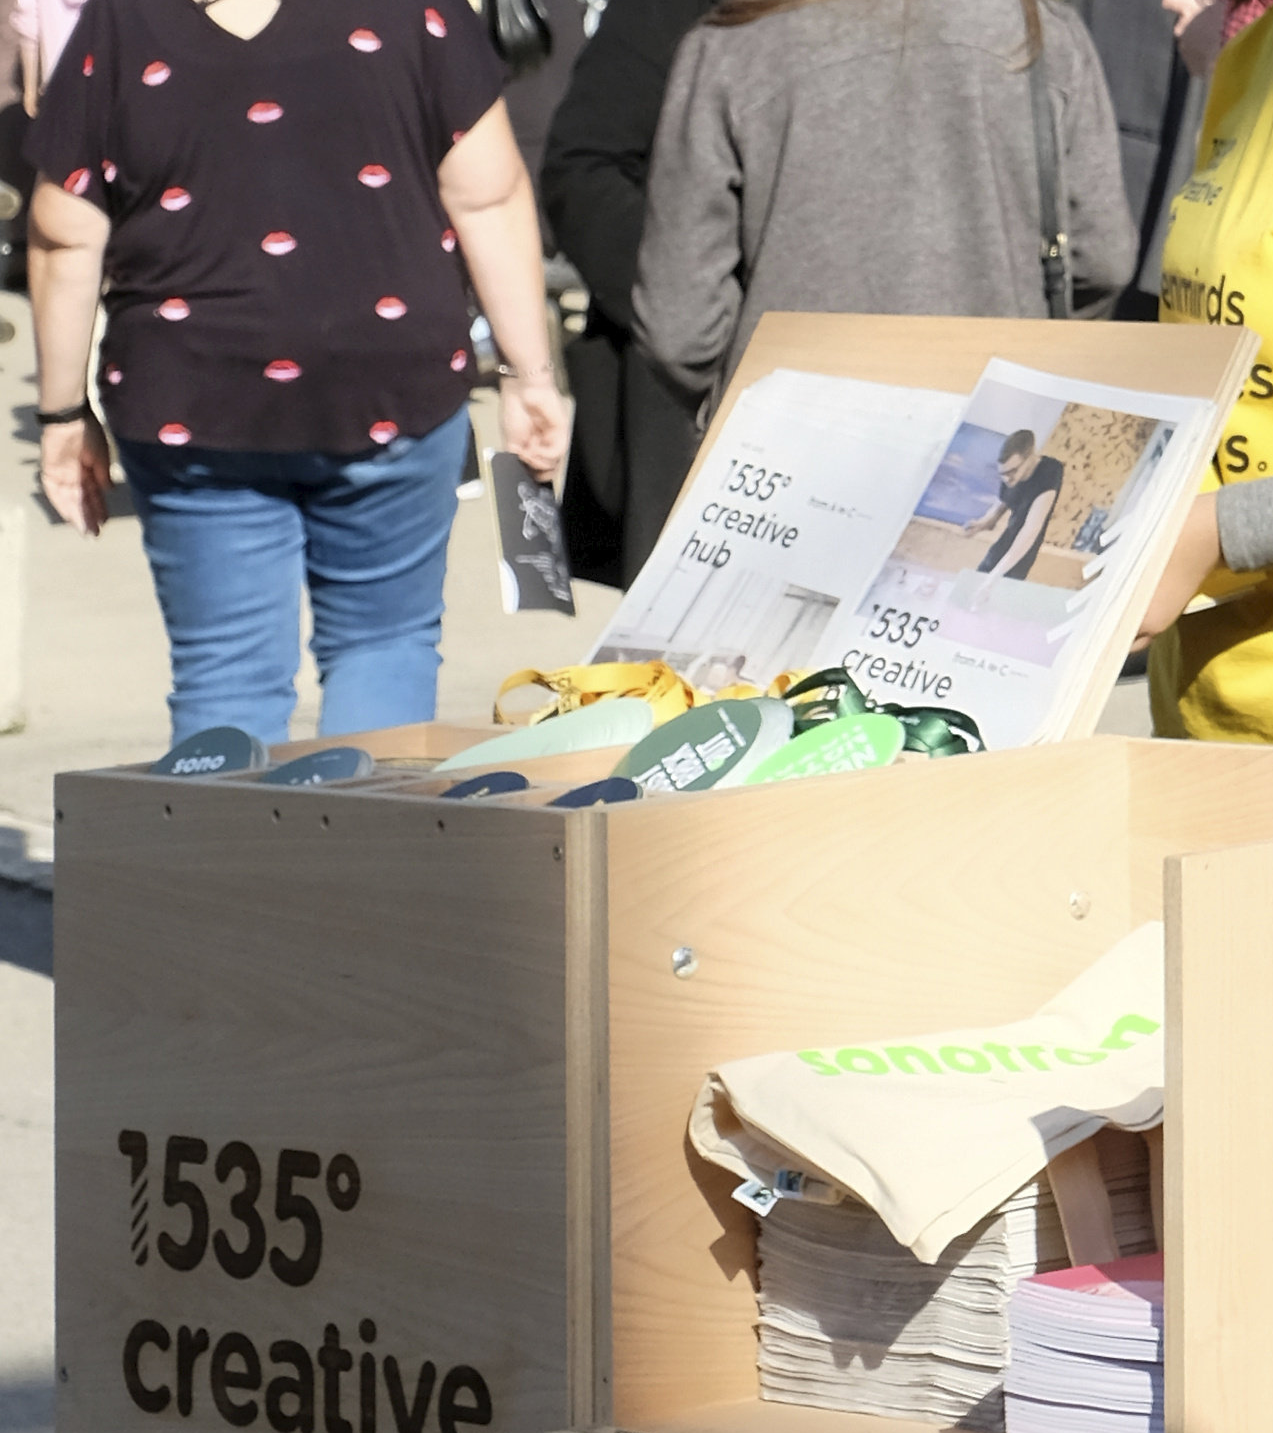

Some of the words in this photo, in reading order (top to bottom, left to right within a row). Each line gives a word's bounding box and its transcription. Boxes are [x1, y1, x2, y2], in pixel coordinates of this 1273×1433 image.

[680, 530, 733, 570] hub
[701, 501, 800, 550] creative
[841, 649, 953, 699] creative
[172, 754, 226, 776] sono
[117, 1129, 361, 1289] 1535°
